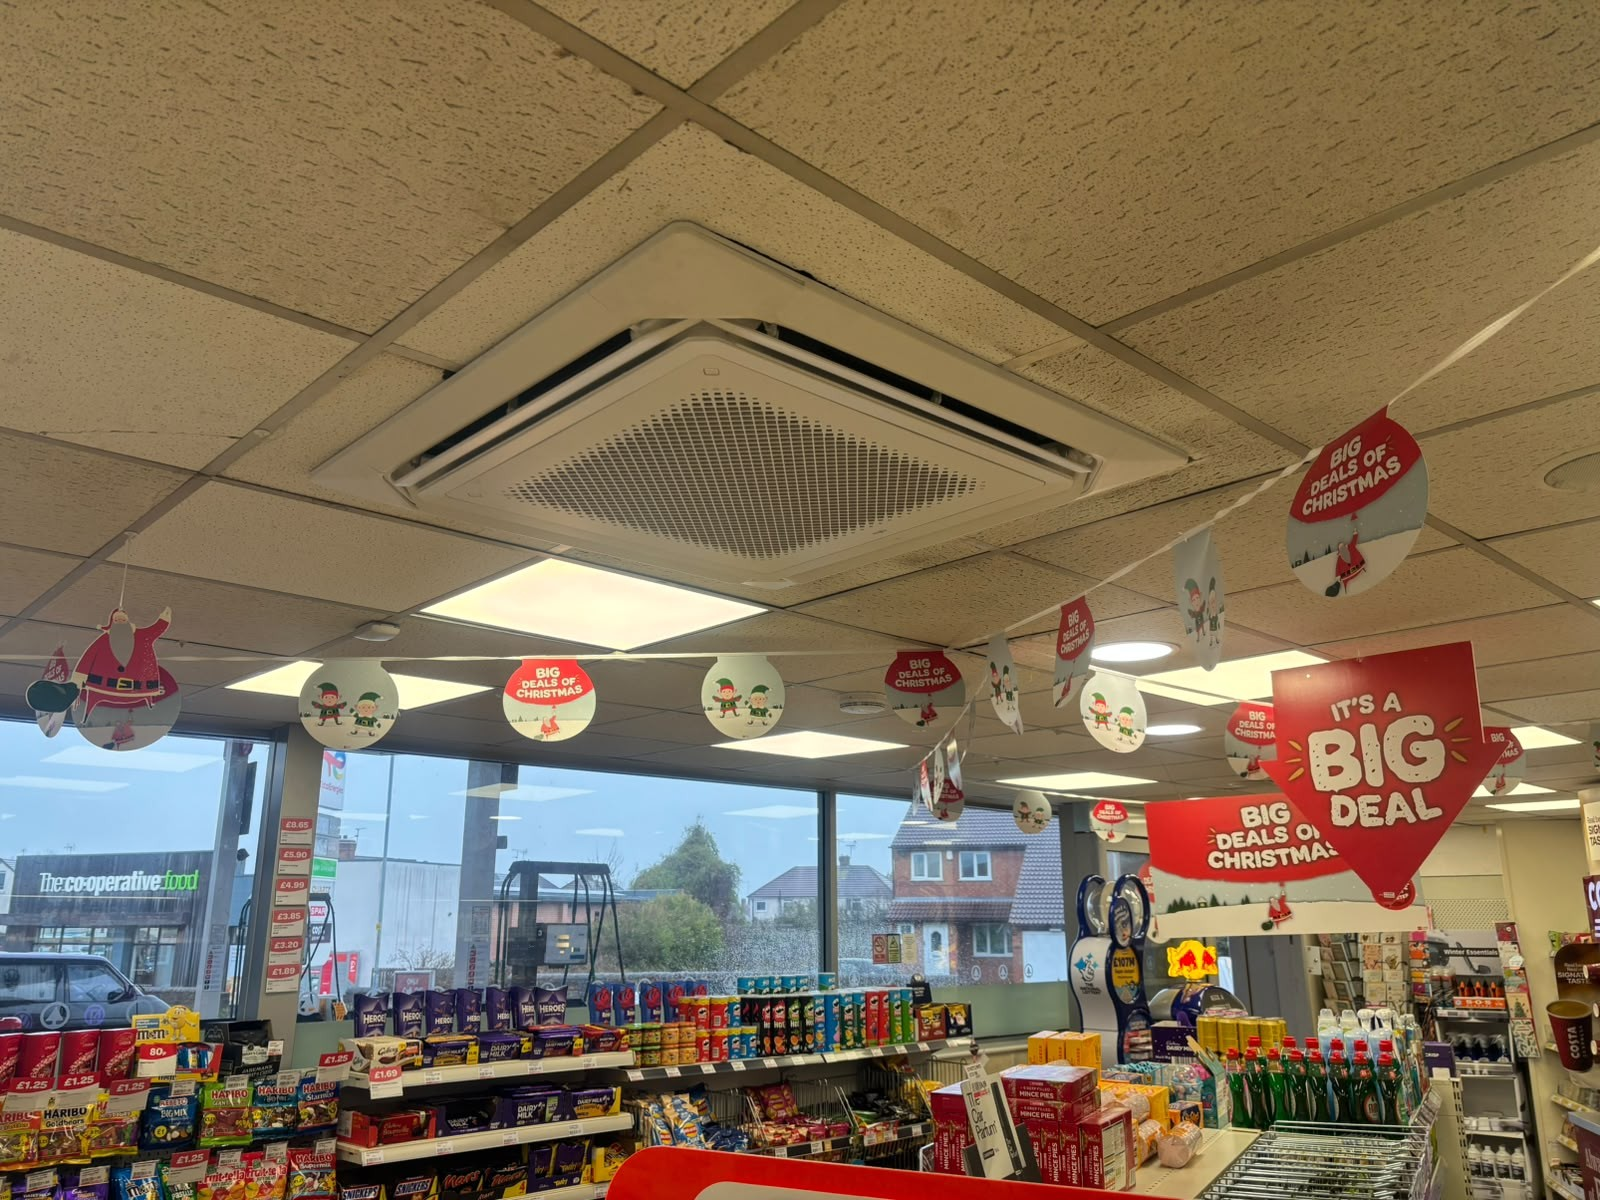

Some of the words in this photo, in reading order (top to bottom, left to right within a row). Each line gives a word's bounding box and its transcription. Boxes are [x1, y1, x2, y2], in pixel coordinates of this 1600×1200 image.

[1330, 435, 1362, 469] BIG
[1311, 459, 1359, 496] DEALS
[1363, 444, 1387, 467] OF
[1302, 456, 1401, 515] CHRISTMAS
[1067, 609, 1080, 628] BIG
[1062, 627, 1079, 643] DEALS
[1079, 620, 1087, 633] OF
[1060, 631, 1090, 655] CHRISTMAS
[909, 658, 931, 669] BIG
[535, 667, 560, 678] BIG
[899, 669, 930, 679] DEALS
[522, 679, 558, 688] DEALS
[561, 677, 576, 686] OF
[895, 674, 952, 688] CHRISTMAS
[516, 685, 583, 699] CHRISTMAS
[1331, 693, 1375, 722] IT'S
[1383, 692, 1402, 712] A
[1249, 711, 1266, 721] BIG
[1239, 721, 1265, 730] DEALS
[1234, 728, 1276, 739] CHRISTMA
[1490, 732, 1505, 743] BIG
[1307, 714, 1446, 792] BIG
[1330, 787, 1443, 828] DEAL
[1240, 802, 1291, 828] BIG
[286, 821, 309, 829] £8.65
[1215, 826, 1289, 850] DEALS
[283, 851, 308, 859] £5.90
[40, 872, 62, 892] The
[65, 871, 162, 896] co-operative
[164, 869, 199, 892] food
[280, 881, 305, 889] £4.99
[277, 912, 301, 920] £3.85
[310, 906, 326, 916] SPAR
[274, 941, 299, 949] £3.20
[540, 1004, 565, 1014] HEROES
[1567, 1026, 1580, 1059] COSTA
[324, 1054, 349, 1064] £1.25
[374, 1069, 398, 1079] £1.69
[16, 1080, 48, 1090] £1.25
[64, 1075, 95, 1087] £1.25
[303, 1081, 336, 1092] HARIBO
[116, 1082, 145, 1092] £1.25
[258, 1086, 295, 1096] HARIBO
[1020, 1090, 1040, 1098] MINCE
[44, 1107, 87, 1119] HARIBO
[161, 1109, 173, 1118] BIG
[174, 1108, 188, 1117] MIX
[517, 1104, 538, 1113] DAIRY
[517, 1111, 533, 1120] MILK
[970, 1108, 984, 1123] Car
[46, 1119, 84, 1128] Goldbears
[976, 1121, 998, 1140] Parfum
[176, 1153, 204, 1165] £1.25
[295, 1153, 332, 1163] HARIBO
[444, 1170, 480, 1188] Mars
[342, 1185, 379, 1200] SNICKERS
[396, 1181, 430, 1193] SNICKERS
